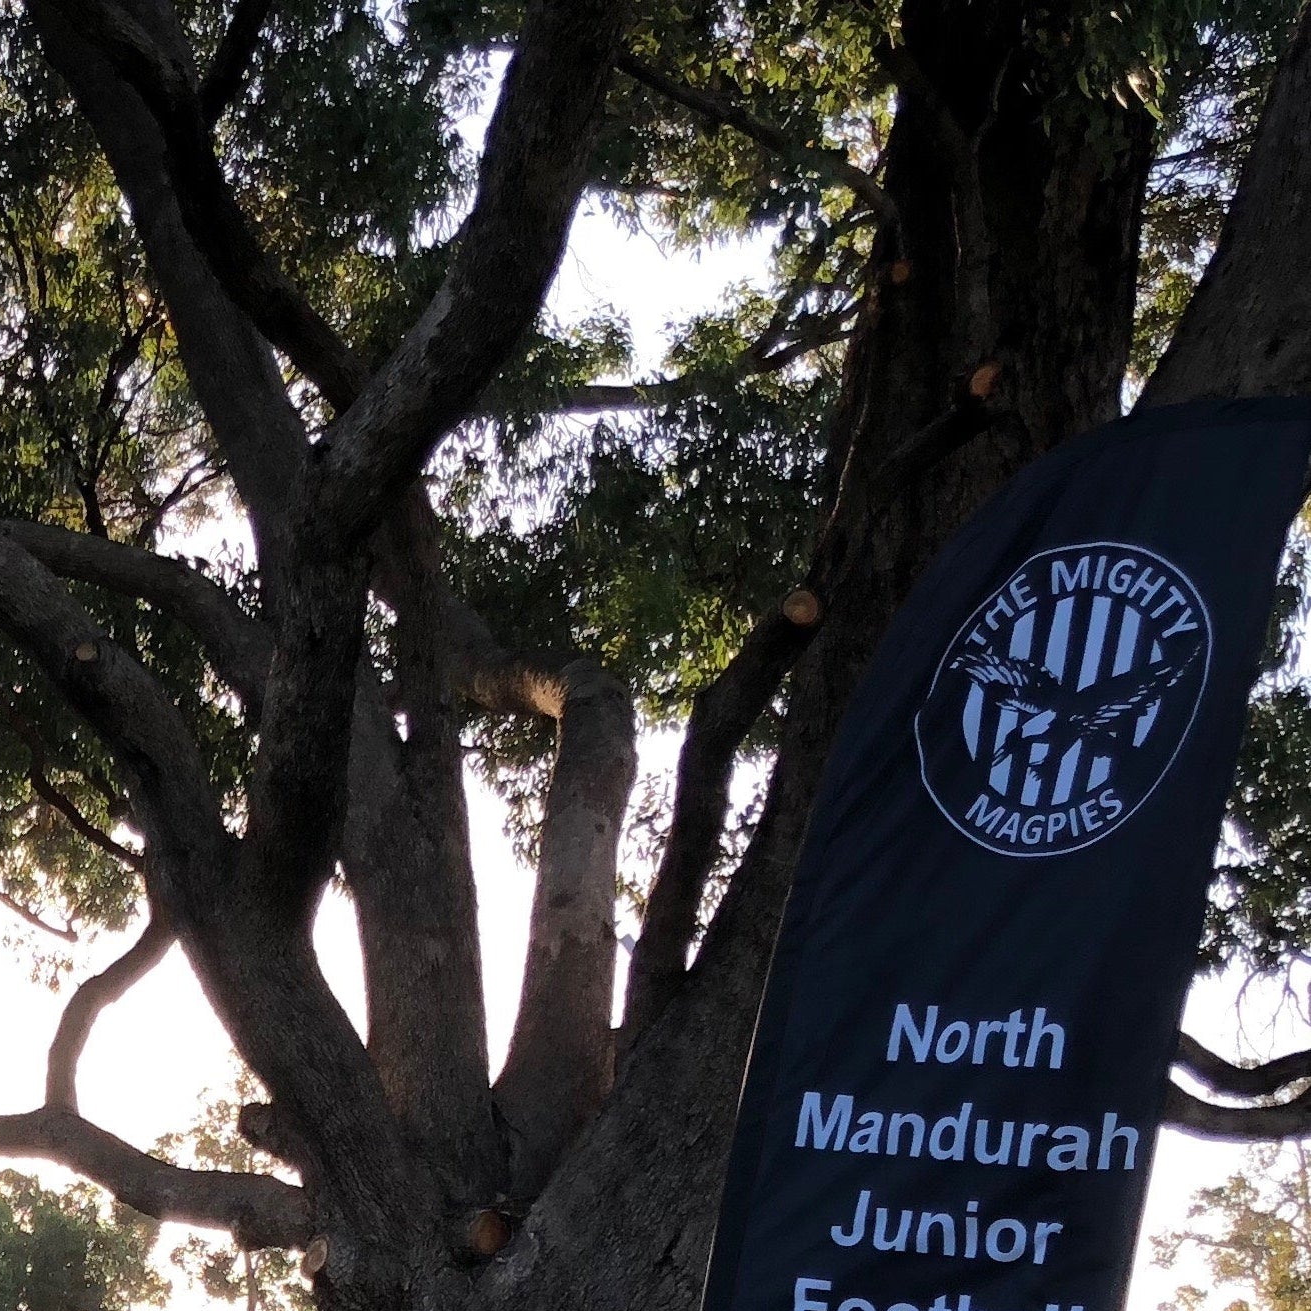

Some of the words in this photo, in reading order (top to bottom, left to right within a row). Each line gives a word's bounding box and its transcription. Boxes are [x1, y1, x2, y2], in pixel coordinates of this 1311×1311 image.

[965, 573, 1038, 646] THE
[1051, 555, 1198, 639] MIGHTY
[964, 788, 1123, 845] MAGPIES
[886, 1003, 1066, 1069] North
[794, 1091, 1139, 1171] Mandurah
[830, 1189, 1064, 1265] Junior
